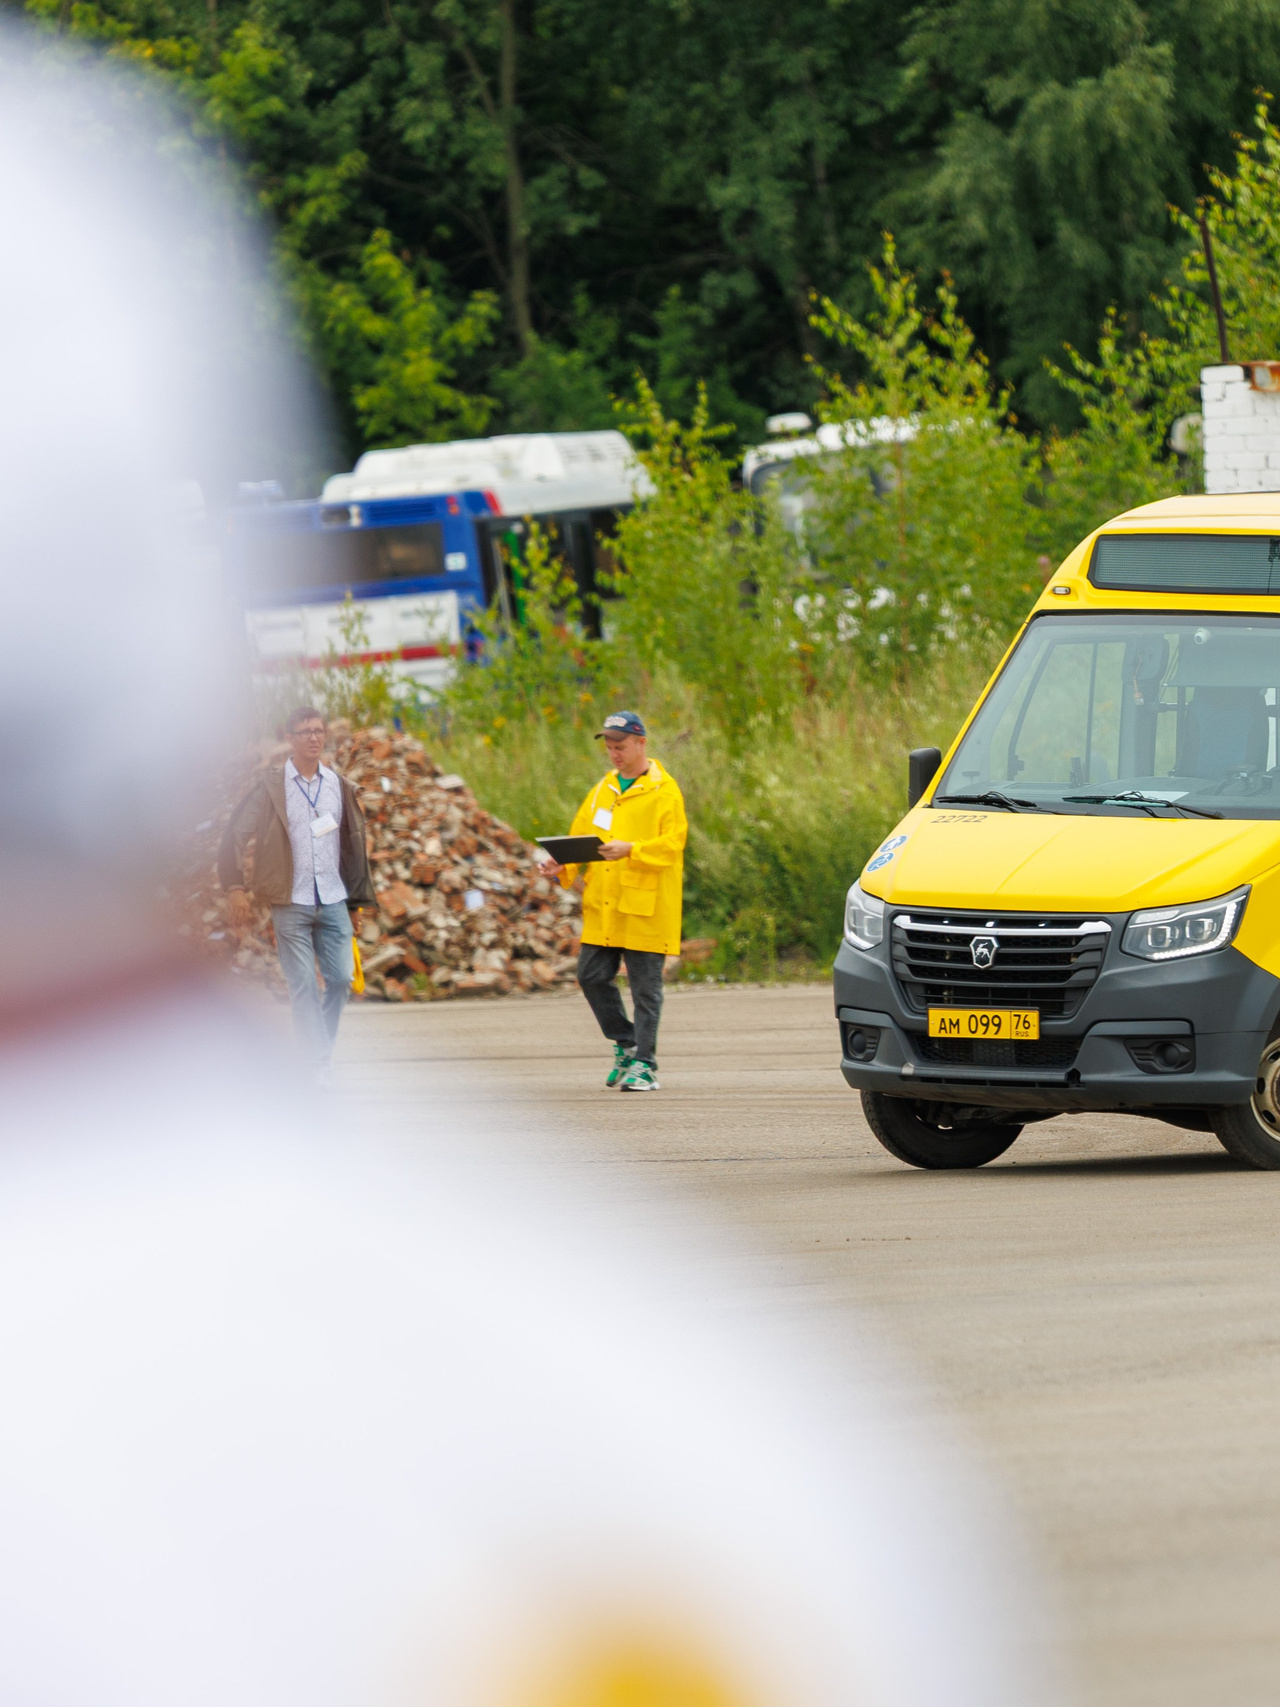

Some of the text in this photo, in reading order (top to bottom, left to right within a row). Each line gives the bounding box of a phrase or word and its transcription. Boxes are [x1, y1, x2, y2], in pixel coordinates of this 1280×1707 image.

[931, 814, 988, 824] 22722
[968, 1013, 1002, 1035] 099
[1013, 1014, 1031, 1030] 76
